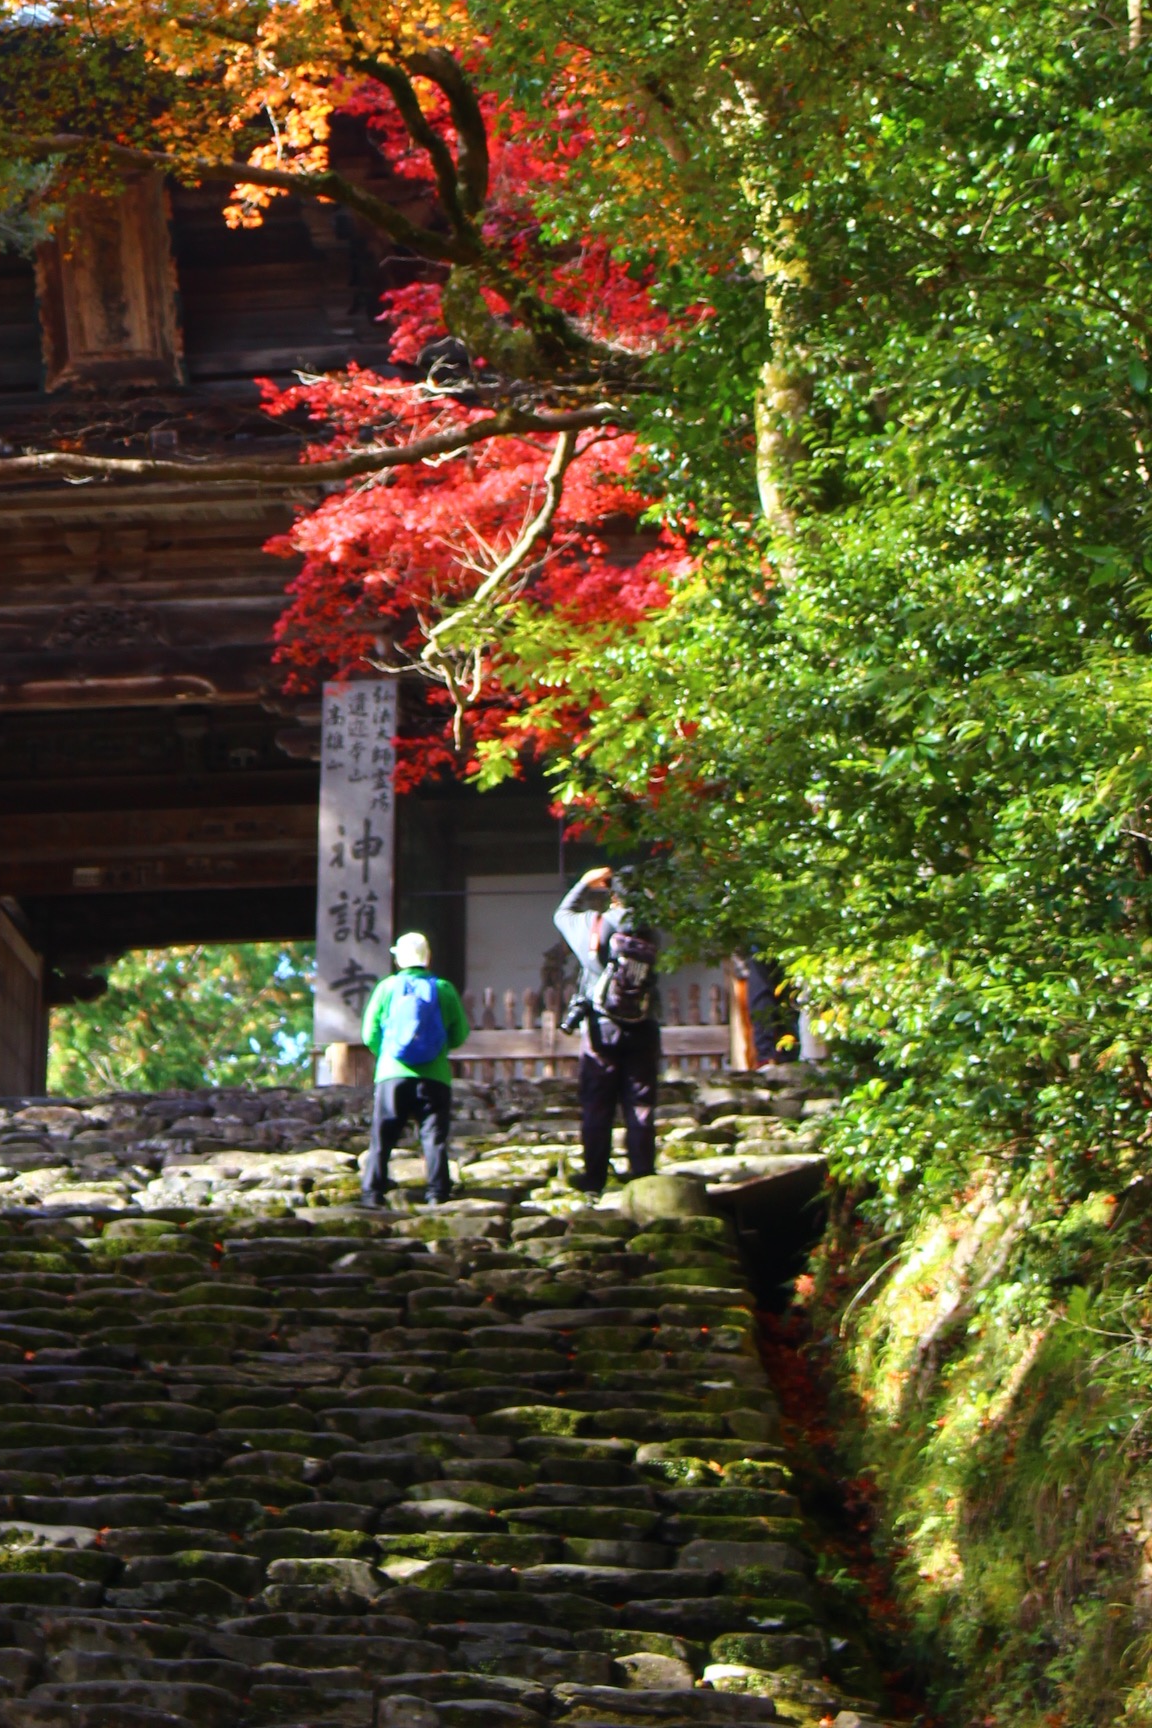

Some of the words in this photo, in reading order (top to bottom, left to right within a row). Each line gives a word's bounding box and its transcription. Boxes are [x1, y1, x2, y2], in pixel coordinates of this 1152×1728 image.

[326, 703, 345, 770] 高雄山
[329, 818, 384, 1018] 神護寺
